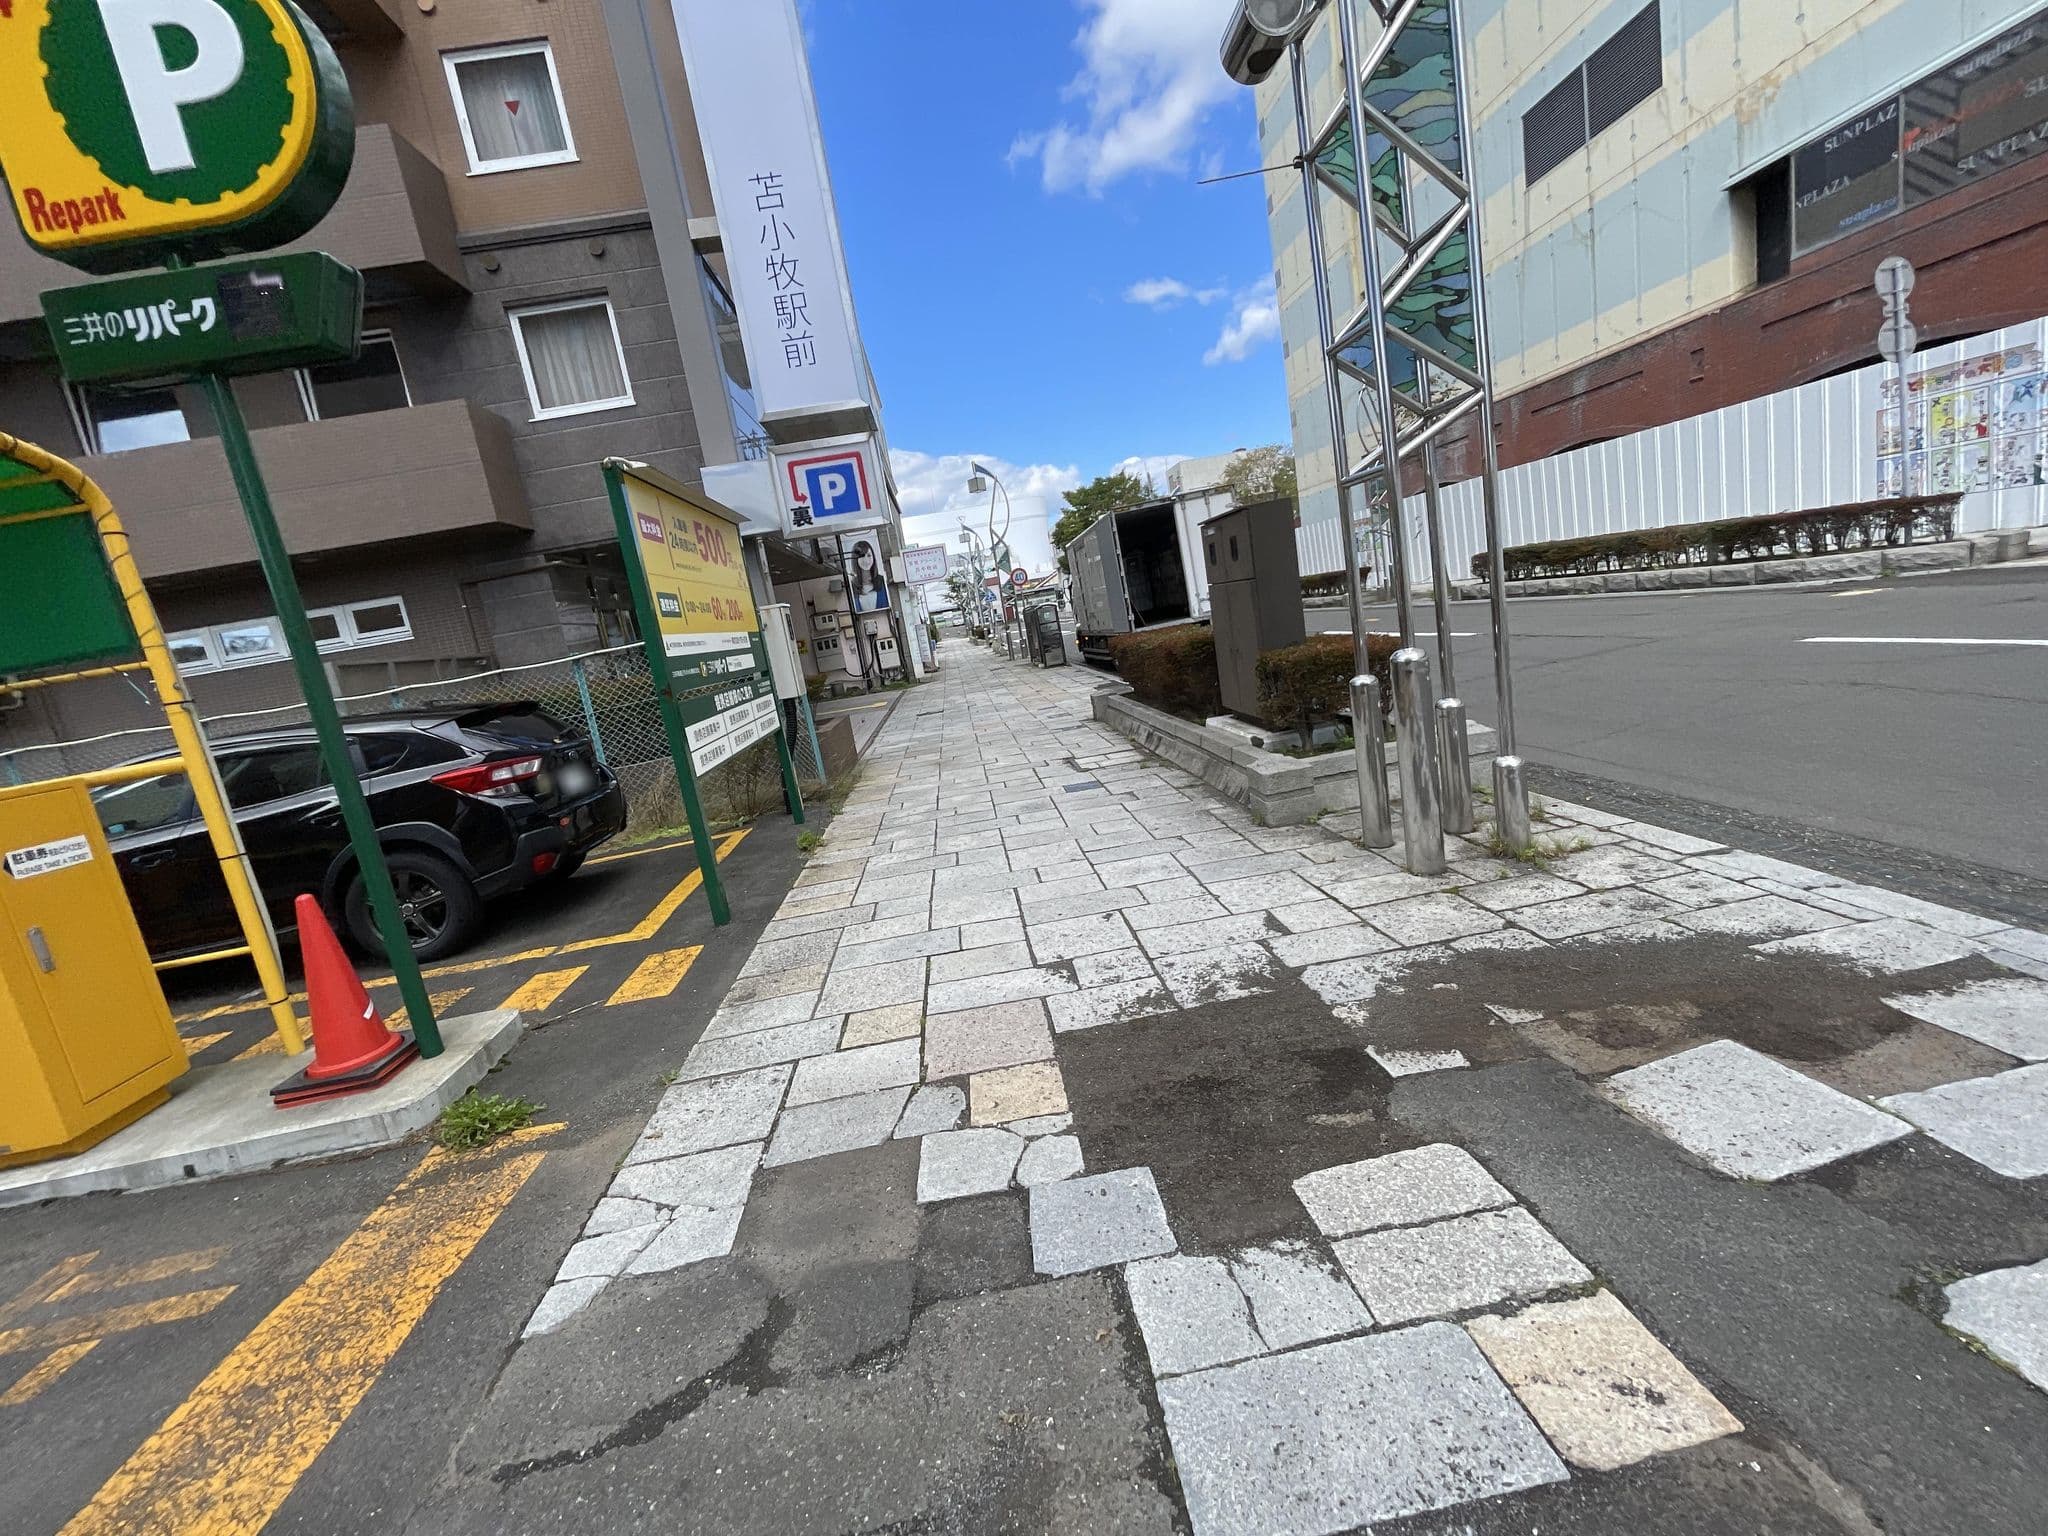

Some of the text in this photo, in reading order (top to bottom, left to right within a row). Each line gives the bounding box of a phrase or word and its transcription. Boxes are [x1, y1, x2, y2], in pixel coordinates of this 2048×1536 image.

[97, 0, 245, 175] P
[23, 186, 126, 234] Repark
[747, 171, 816, 369] 苫小牧駅前
[63, 297, 217, 345] 三井のリパーク
[818, 473, 847, 510] P
[790, 505, 815, 527] 裏
[1015, 572, 1025, 582] 40
